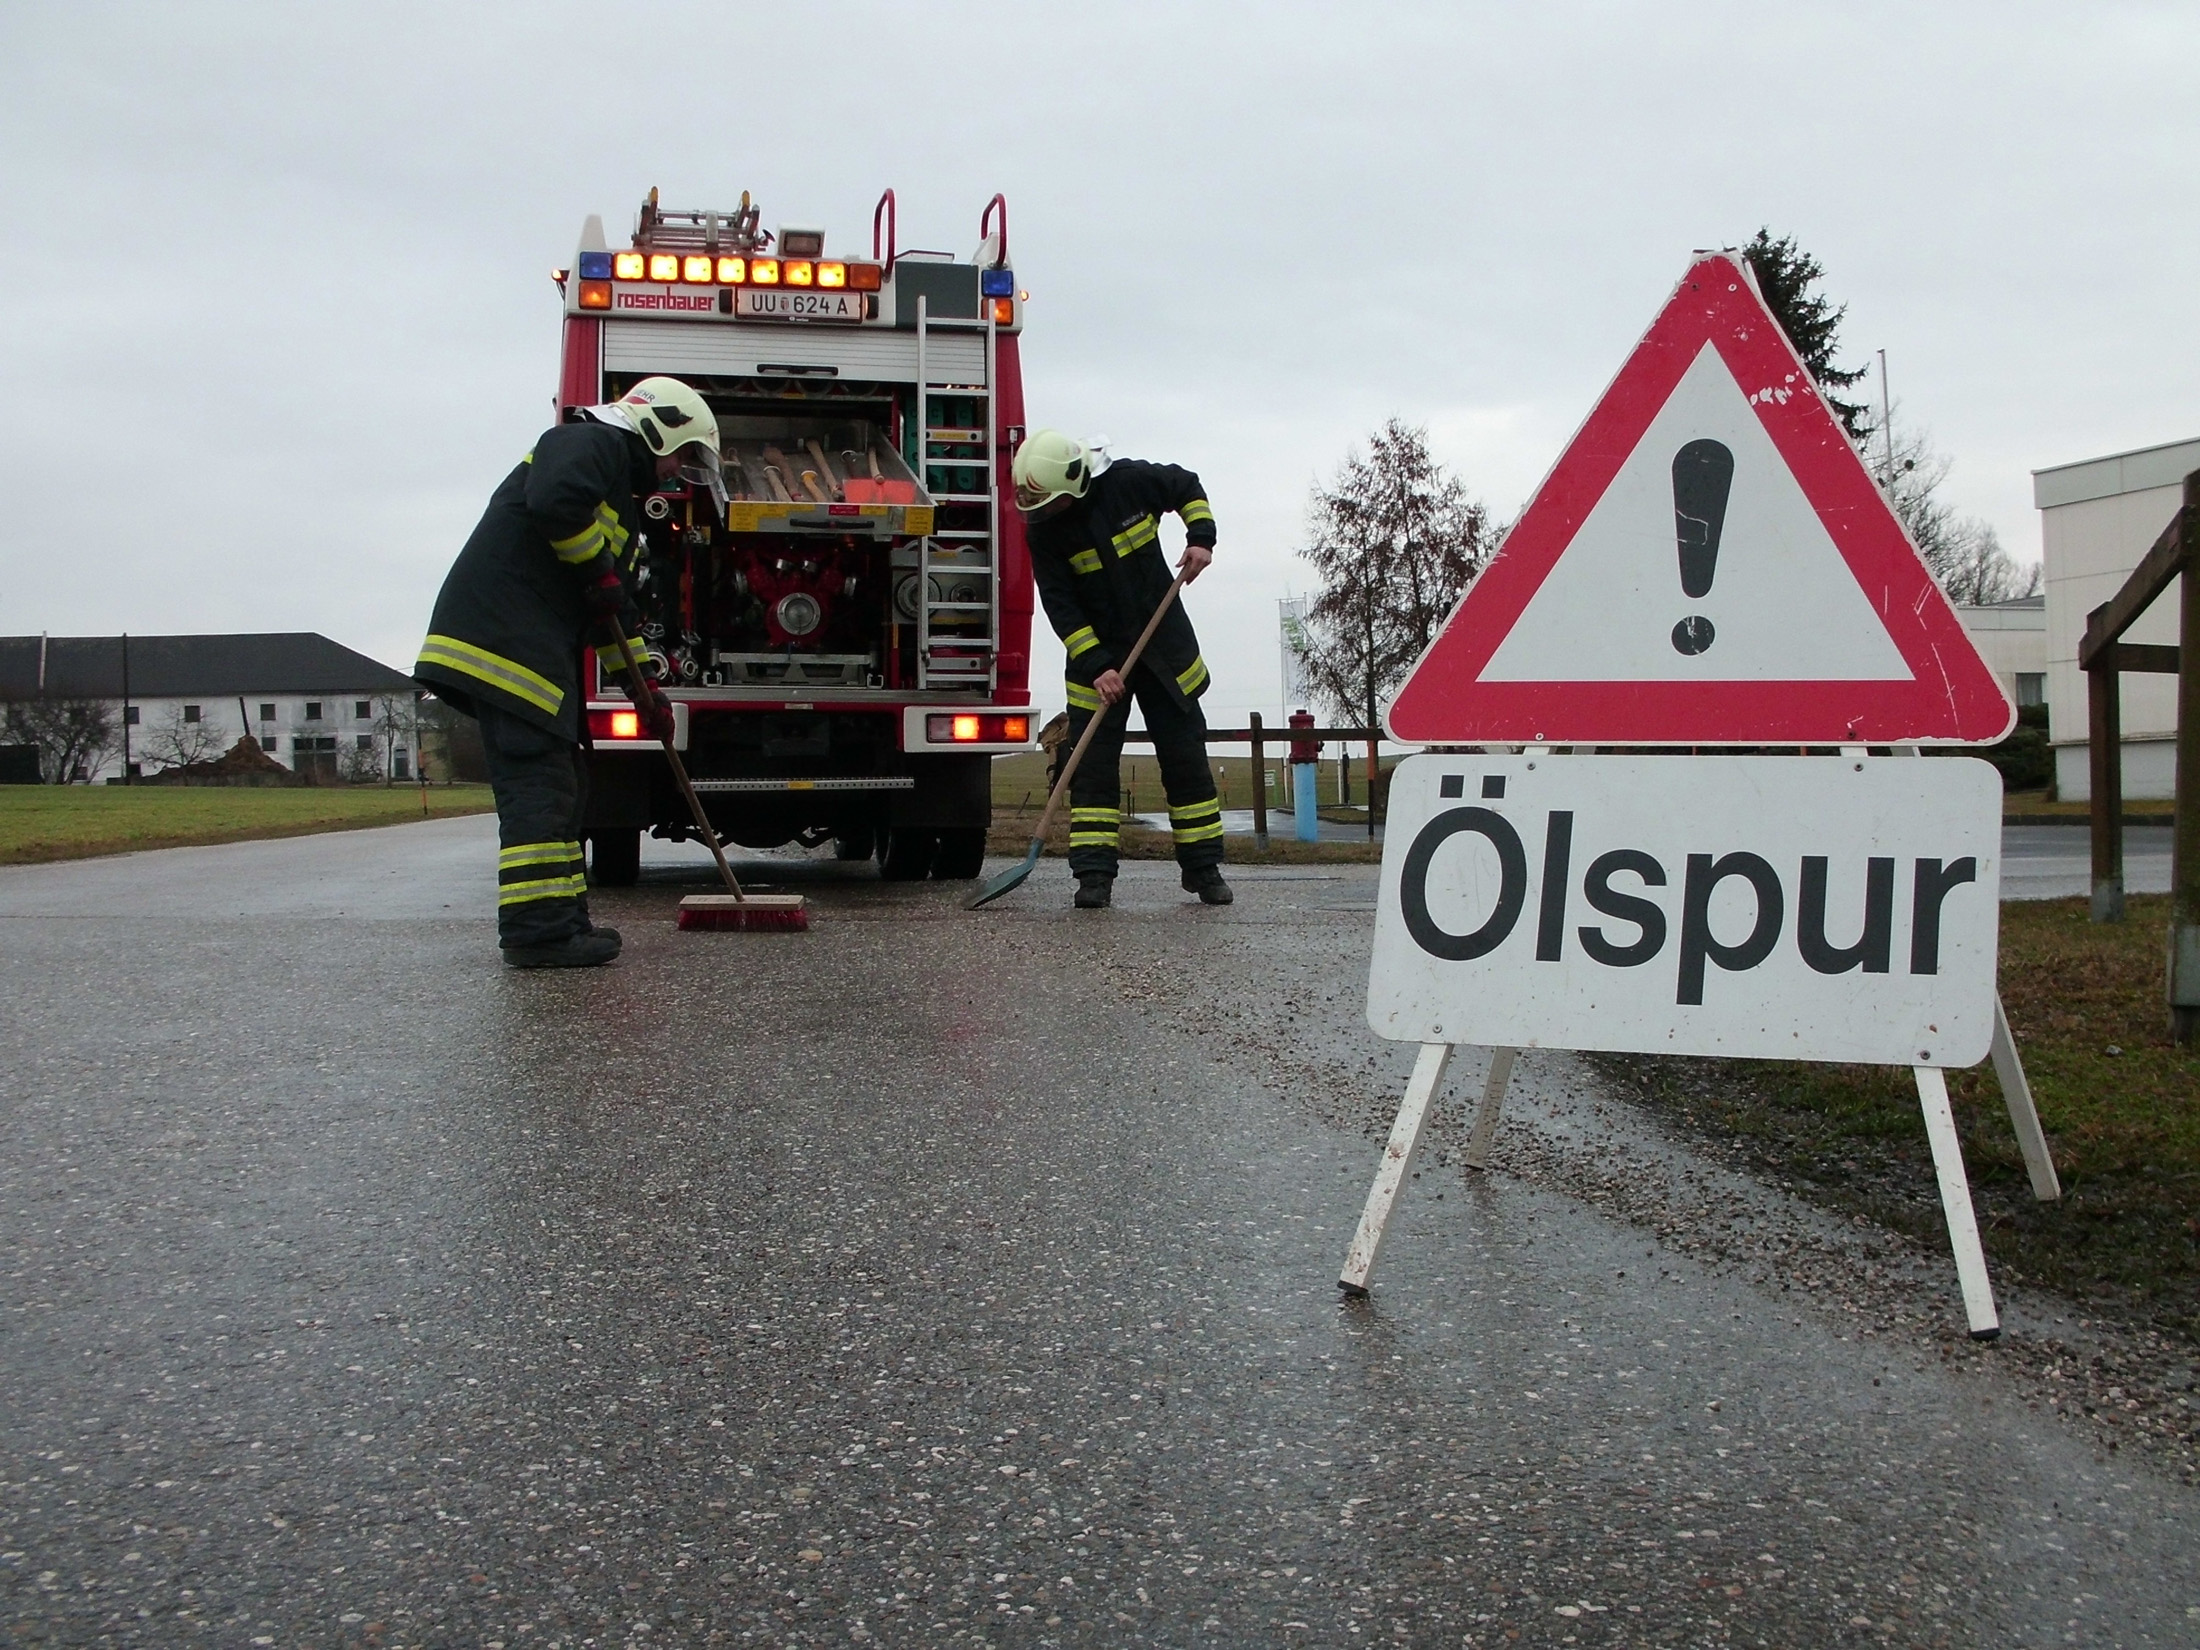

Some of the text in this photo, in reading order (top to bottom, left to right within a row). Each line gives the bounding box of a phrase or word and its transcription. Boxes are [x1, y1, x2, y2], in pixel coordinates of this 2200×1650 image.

[617, 286, 715, 311] rosenbauer
[751, 294, 848, 315] UU 624 A
[1400, 775, 1976, 1006] Ölspur
